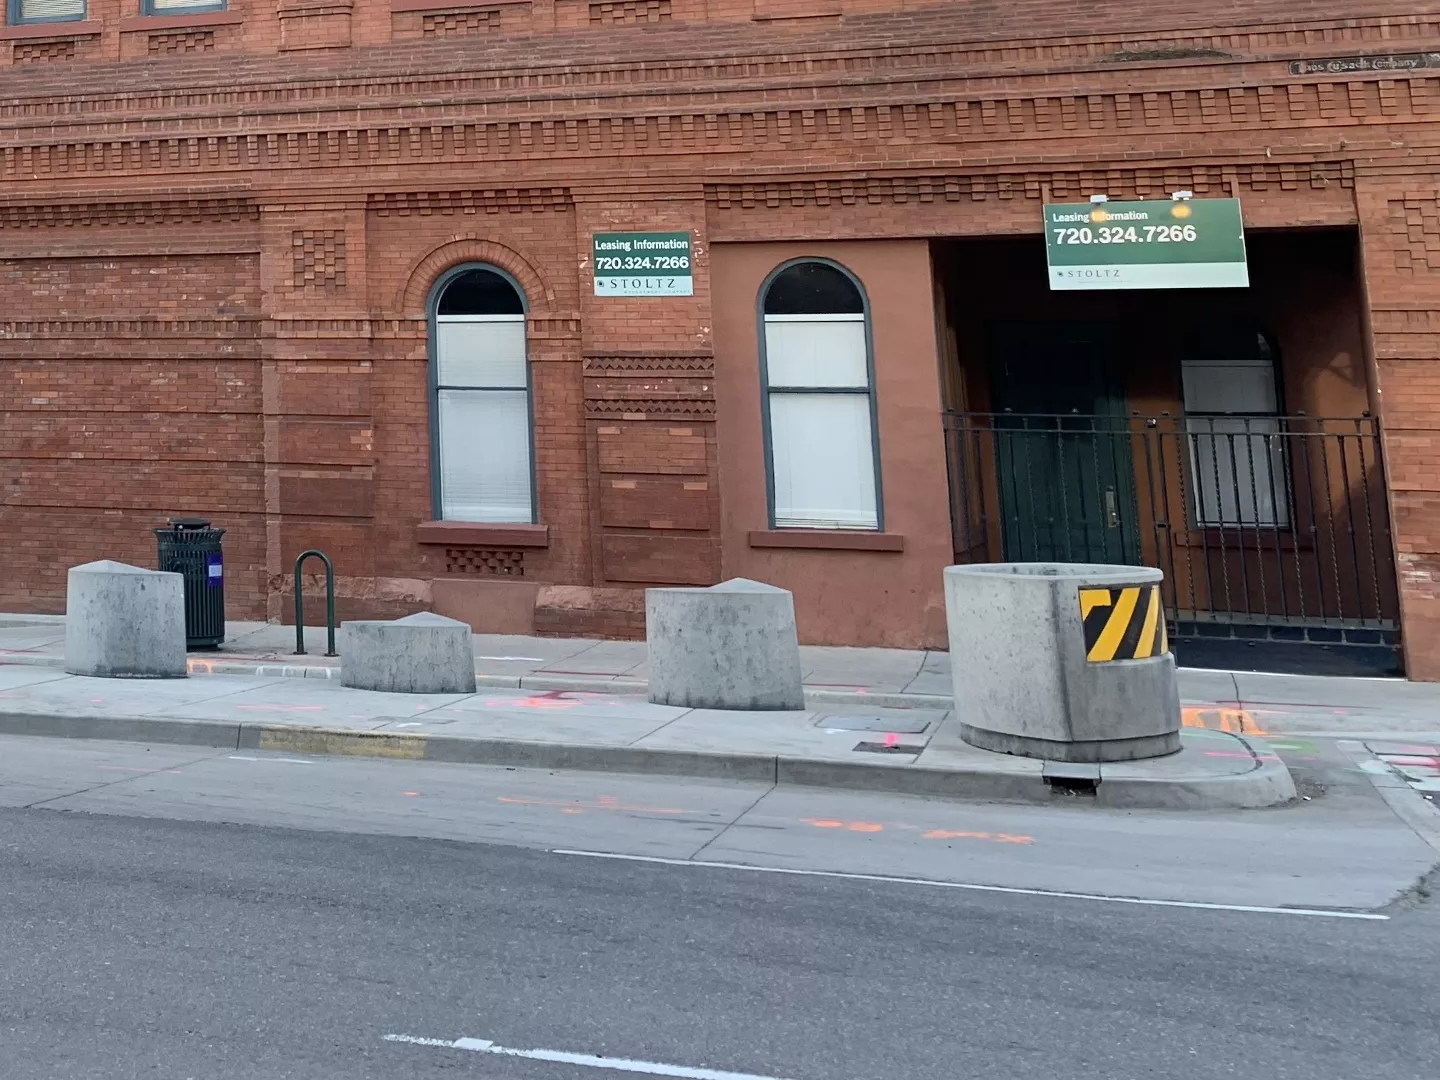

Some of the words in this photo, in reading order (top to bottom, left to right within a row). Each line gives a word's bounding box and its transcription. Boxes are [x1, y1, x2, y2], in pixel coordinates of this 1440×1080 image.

[1053, 212, 1090, 223] Leasing
[1053, 224, 1197, 245] 720.324.7266
[595, 240, 631, 251] Leasing
[633, 239, 688, 249] Information
[595, 256, 690, 270] 720.324.7266
[1067, 269, 1120, 278] STOLTZ
[610, 278, 676, 289] STOLTZ
